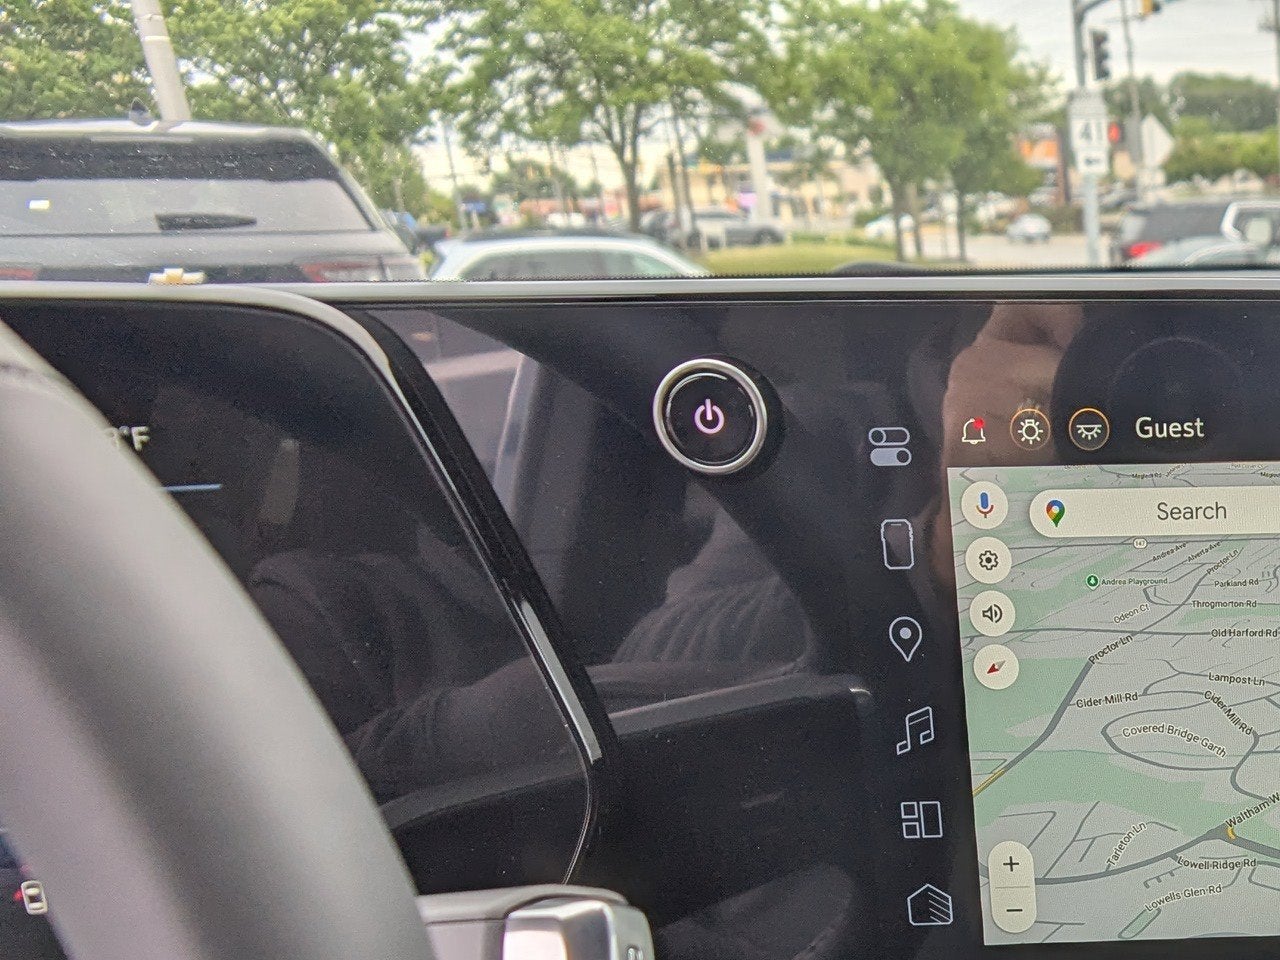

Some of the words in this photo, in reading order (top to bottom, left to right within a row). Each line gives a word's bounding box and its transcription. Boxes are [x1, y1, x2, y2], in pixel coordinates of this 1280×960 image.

[1135, 416, 1204, 439] Guest
[1157, 501, 1227, 521] Search
[1152, 548, 1175, 562] Andrea
[1206, 554, 1230, 575] Proctor
[1102, 578, 1127, 586] Andrea
[1128, 577, 1168, 586] Playground
[1214, 580, 1247, 588] Parkland
[1249, 578, 1259, 586] Rd
[1192, 600, 1245, 609] Throgmorton
[1246, 600, 1257, 608] Rd
[1114, 606, 1139, 624] Odeon
[1211, 628, 1227, 638] Old
[1228, 628, 1264, 638] Harford
[1266, 628, 1278, 638] Rd
[1088, 639, 1120, 665] Proctor
[1120, 634, 1133, 646] Ln
[1208, 672, 1252, 686] Lampost
[1253, 676, 1265, 686] Ln
[1076, 697, 1103, 709] Cider
[1104, 694, 1123, 705] Mill
[1124, 692, 1138, 702] Rd
[1204, 690, 1228, 710] Cider
[1239, 722, 1254, 736] Rd
[1122, 724, 1165, 738] Covered
[1166, 725, 1200, 743] Bridge
[1200, 737, 1227, 758] Garth
[1225, 798, 1270, 829] Waltham
[1106, 834, 1134, 866] Tarleton
[1132, 822, 1147, 835] Ln
[1177, 856, 1210, 870] Lowell
[1212, 860, 1242, 871] Ridge
[1244, 858, 1257, 868] Rd
[1144, 892, 1181, 912] Lowells
[1183, 888, 1207, 899] Glen
[1208, 884, 1223, 894] Rd
